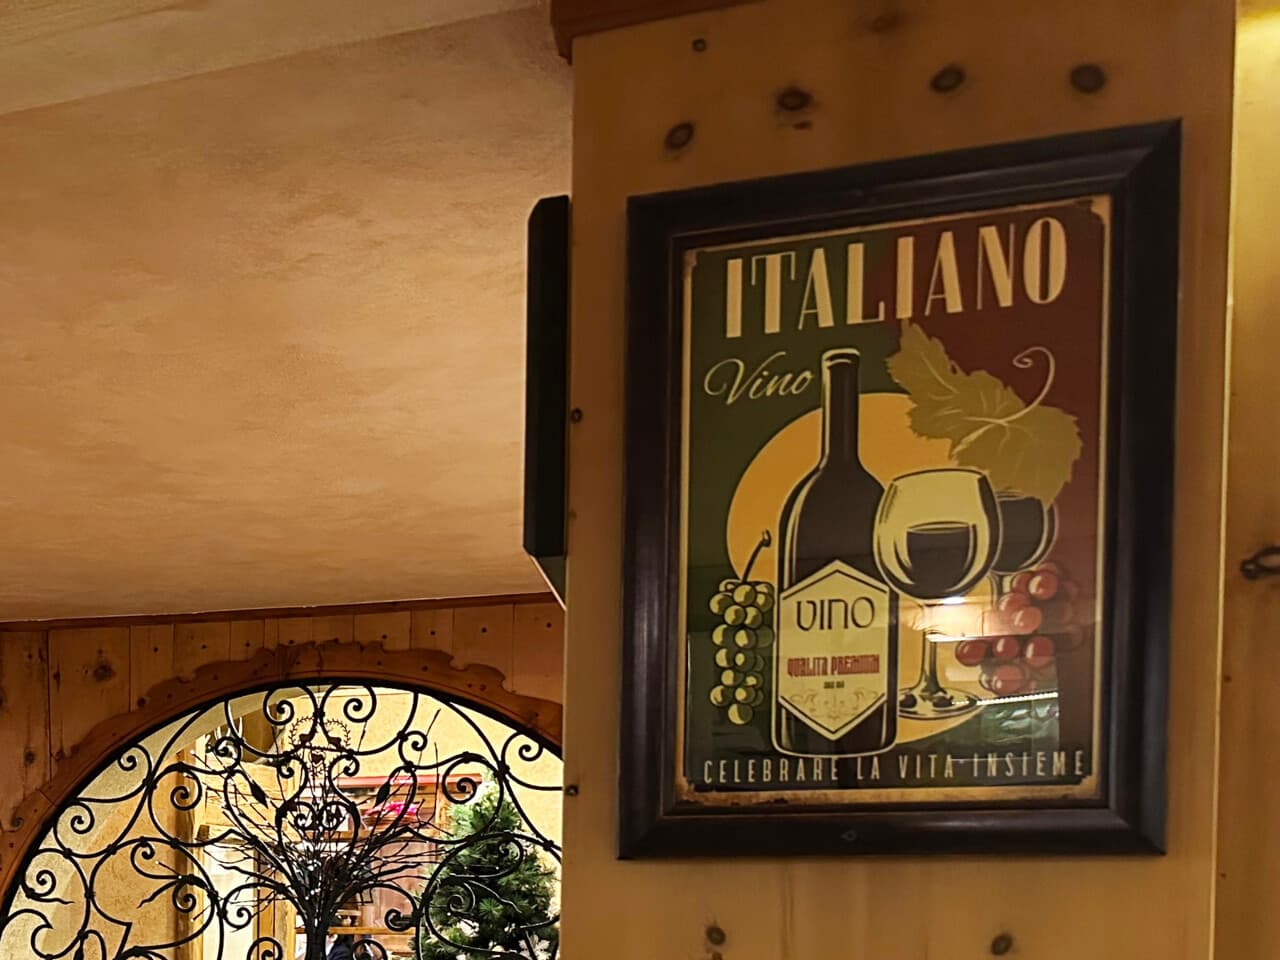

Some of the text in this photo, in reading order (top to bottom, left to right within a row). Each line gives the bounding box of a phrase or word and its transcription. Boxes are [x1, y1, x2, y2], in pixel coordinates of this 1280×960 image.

[726, 217, 1067, 338] ITALIANO
[704, 351, 815, 405] Vino
[703, 750, 1085, 784] CELEBRARE LA VITA INSIEME
